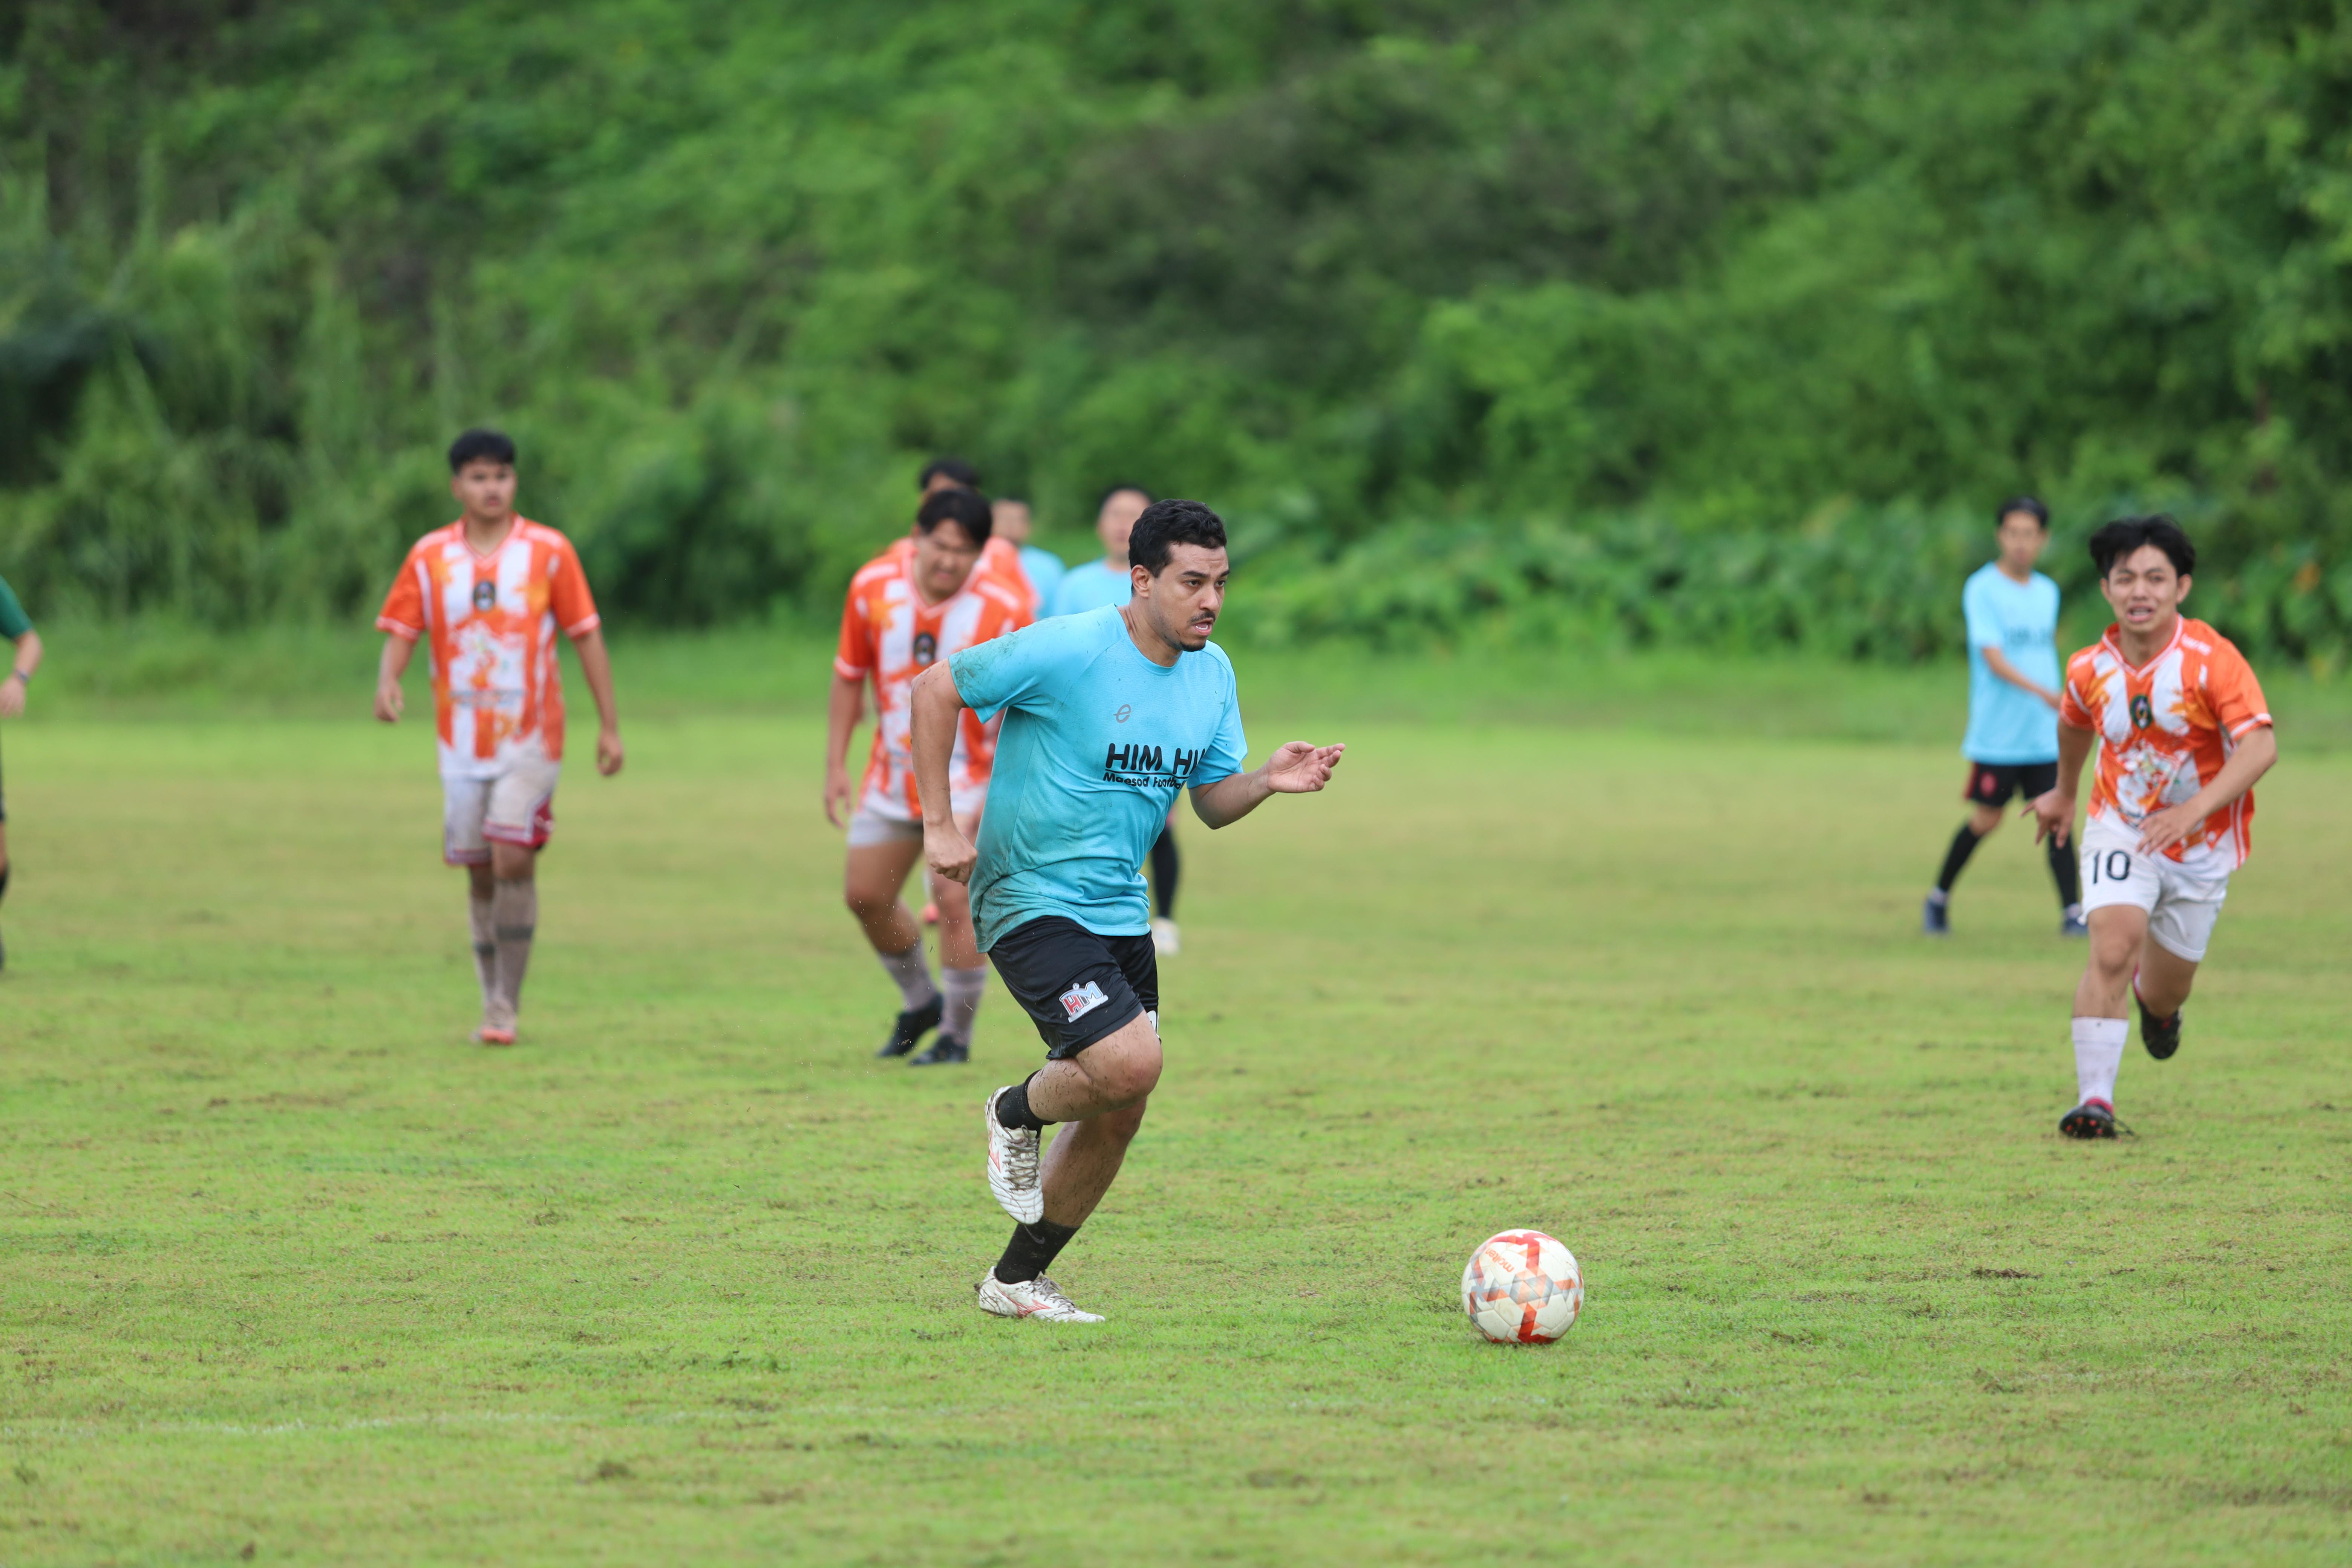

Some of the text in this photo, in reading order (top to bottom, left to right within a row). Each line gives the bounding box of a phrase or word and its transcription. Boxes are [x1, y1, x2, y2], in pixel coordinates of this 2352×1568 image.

[1106, 743, 1205, 775] HIM HI
[1103, 772, 1150, 787] Maesod
[2093, 850, 2131, 884] 10
[1485, 1248, 1514, 1272] molten
